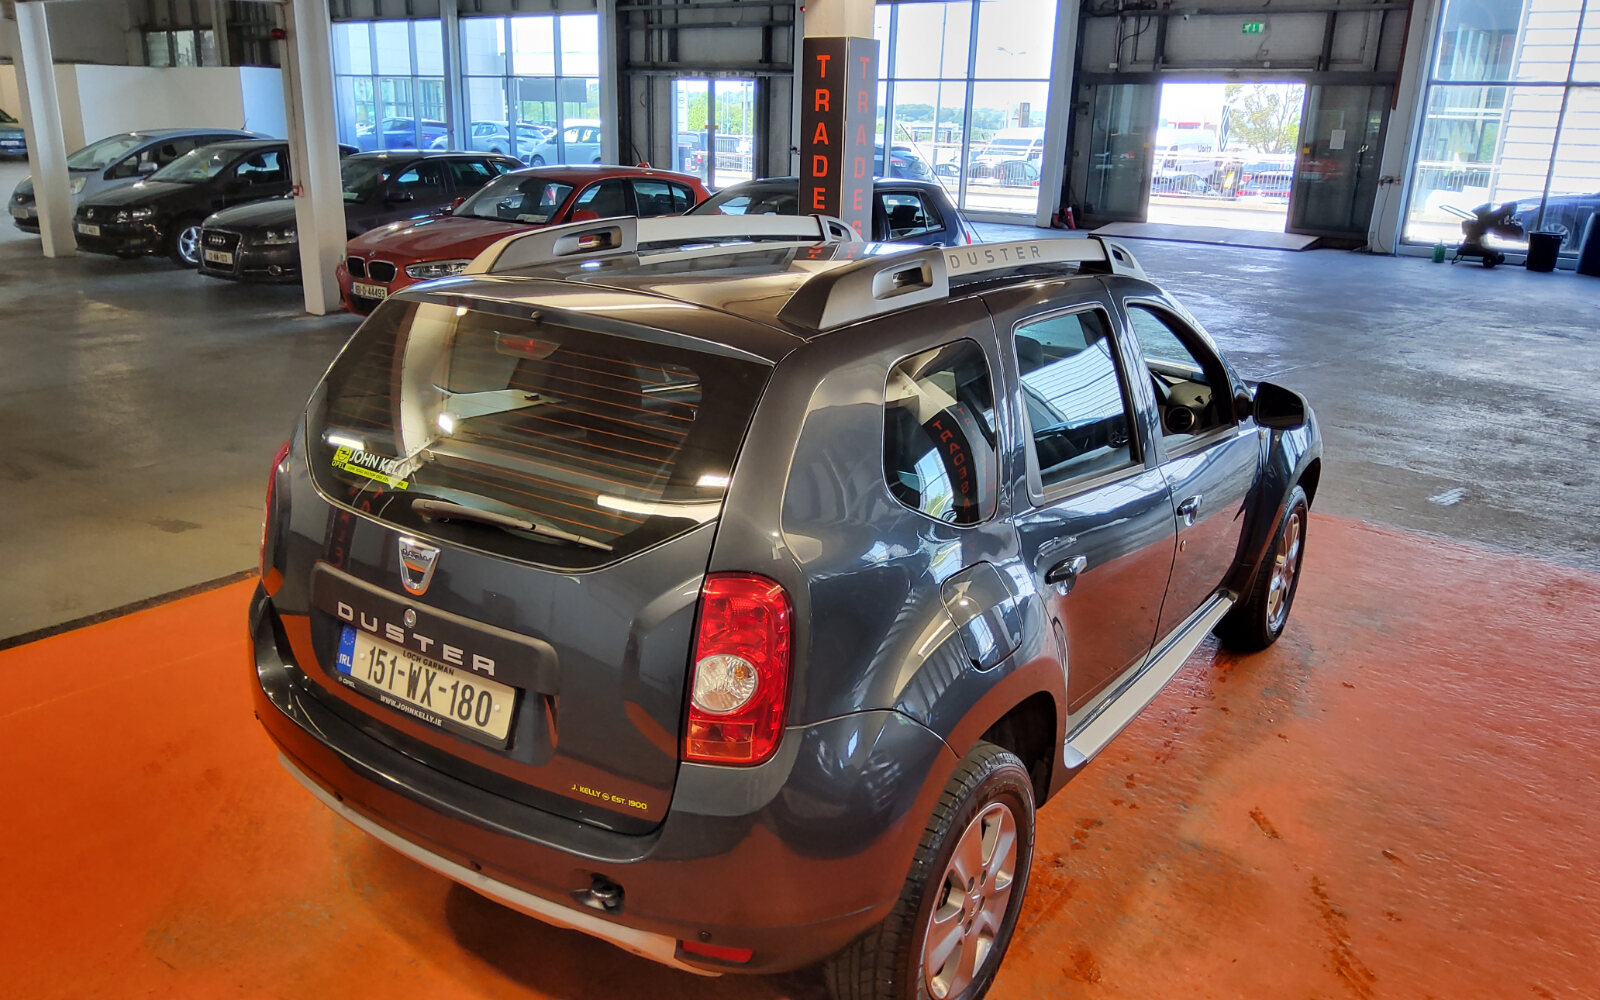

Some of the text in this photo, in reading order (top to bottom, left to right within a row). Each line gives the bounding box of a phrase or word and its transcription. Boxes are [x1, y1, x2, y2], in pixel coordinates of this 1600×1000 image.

[812, 54, 831, 210] TRADE
[949, 245, 1041, 270] DUSTER
[349, 450, 380, 469] JOHN
[337, 601, 495, 676] DUSTER
[339, 653, 351, 667] IRL
[402, 650, 455, 676] LOCH GARMAN
[367, 645, 493, 727] 151-WX-180
[380, 695, 443, 727] WWW.JOHNKELLY.IE
[571, 783, 648, 810] J. KELLY EST. 1900
